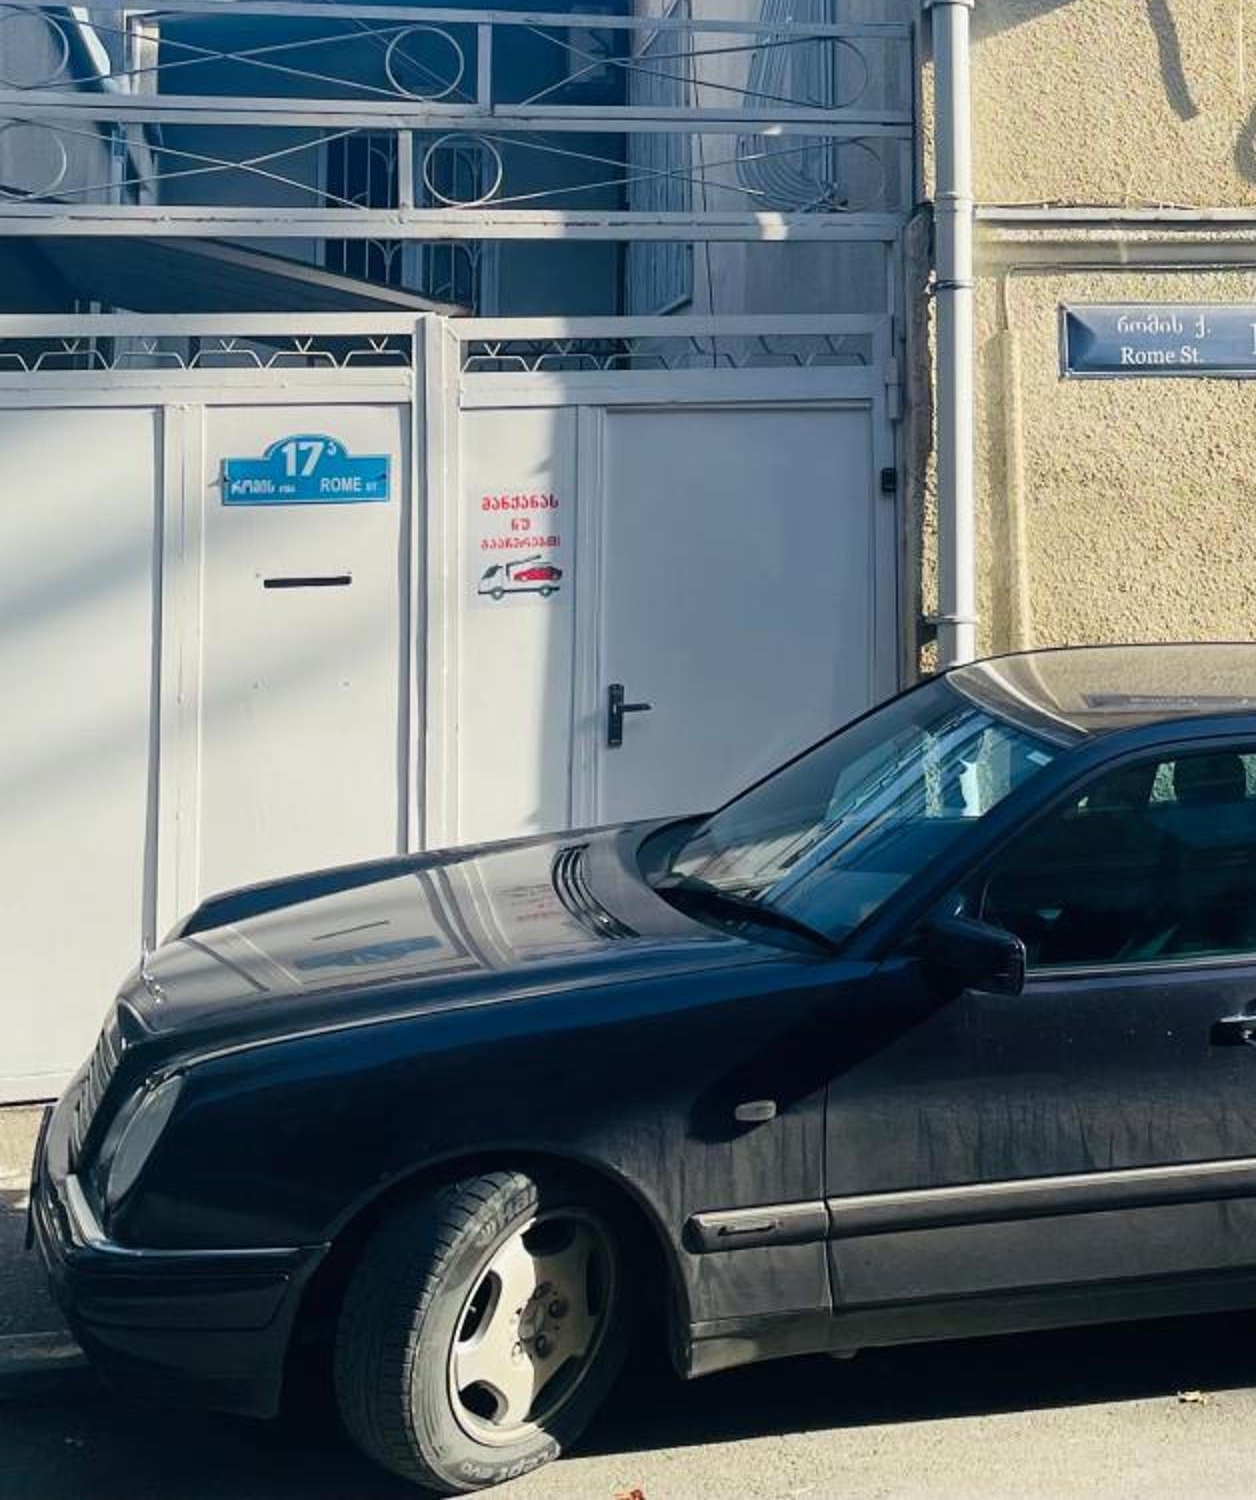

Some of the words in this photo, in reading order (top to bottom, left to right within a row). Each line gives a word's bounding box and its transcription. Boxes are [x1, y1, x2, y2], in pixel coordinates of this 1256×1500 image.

[1117, 314, 1183, 335] რომის
[1120, 346, 1175, 365] Rome
[1180, 346, 1204, 365] St.
[319, 476, 362, 493] ROME
[481, 493, 560, 511] მანქანას
[511, 517, 531, 531] ნუ
